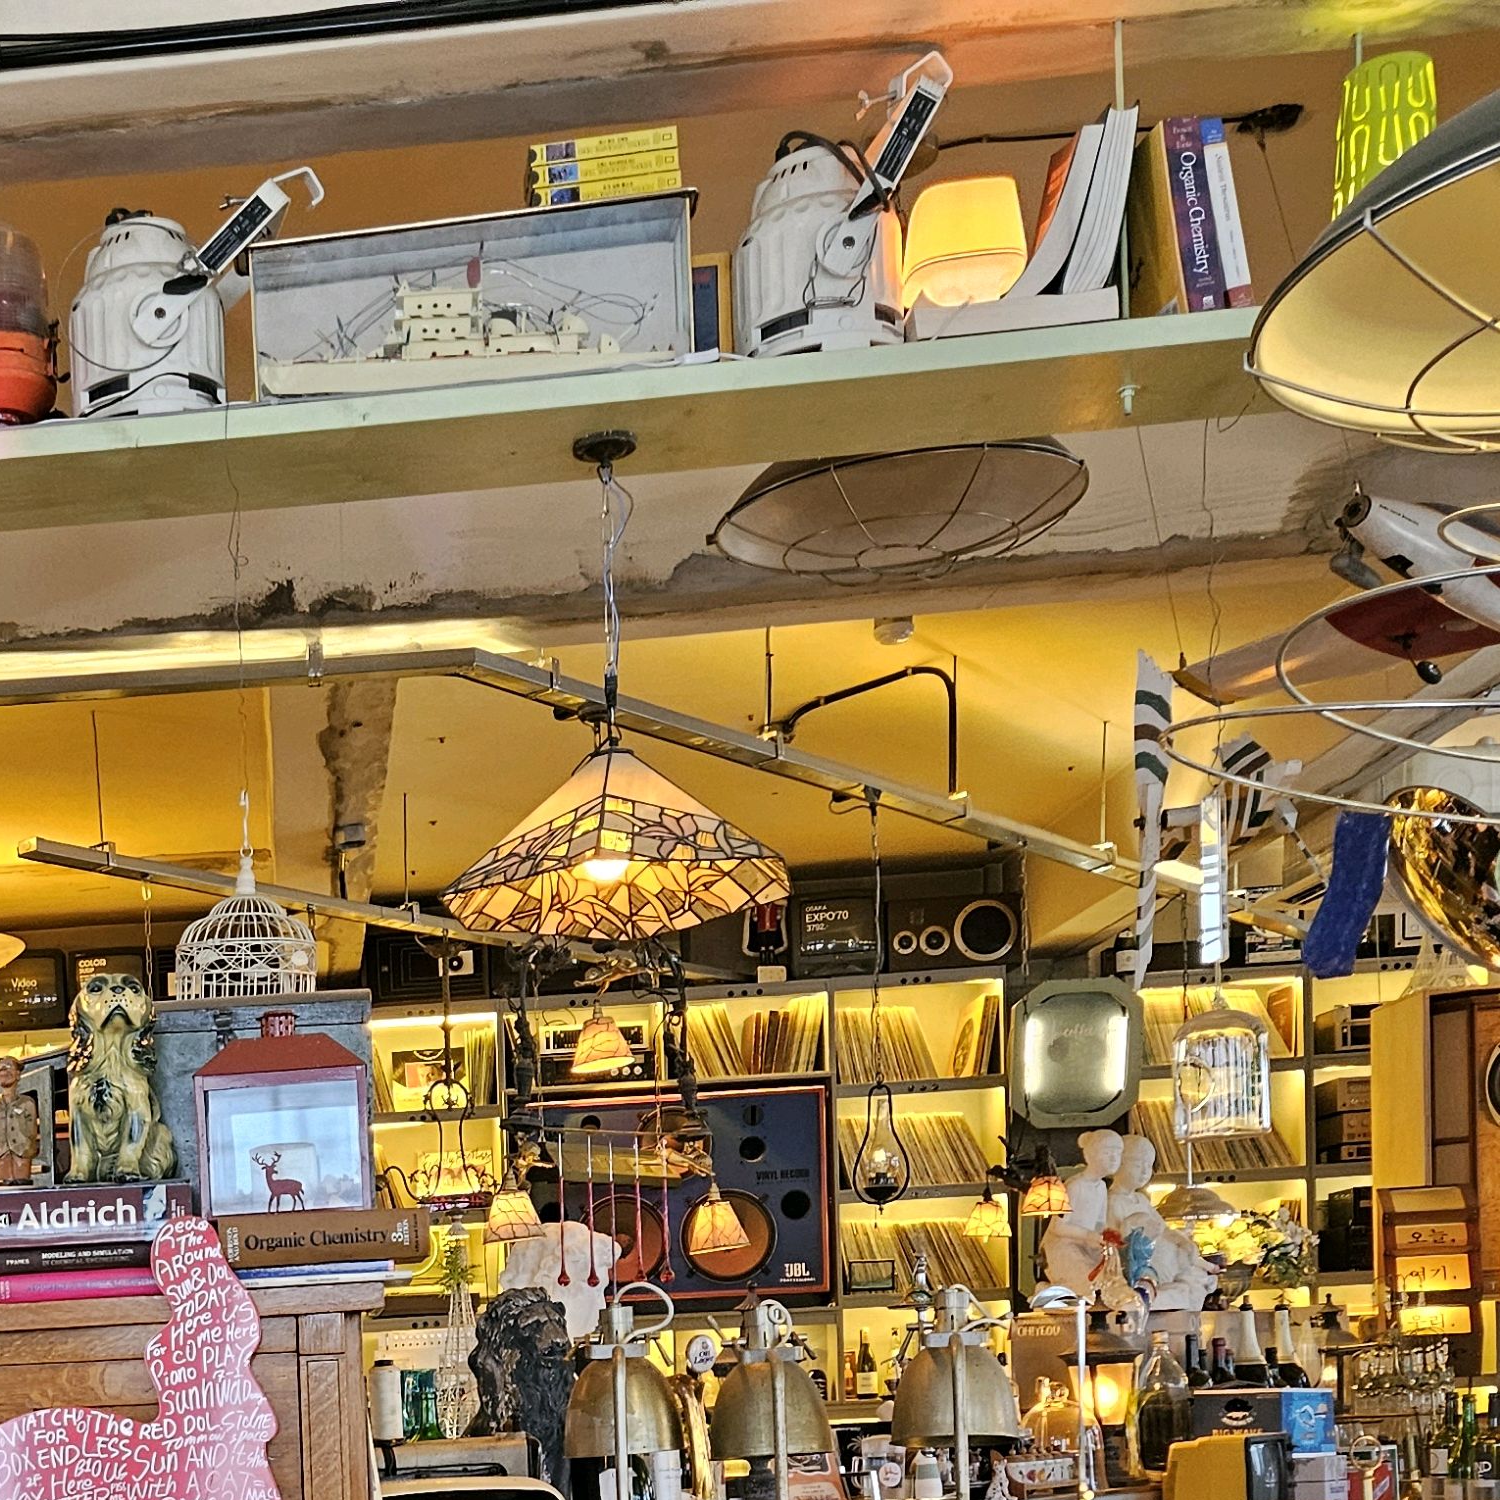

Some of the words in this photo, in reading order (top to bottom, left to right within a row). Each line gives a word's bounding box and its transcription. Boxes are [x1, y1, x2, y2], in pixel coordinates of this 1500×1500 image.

[1178, 151, 1200, 206] Organic
[1188, 206, 1210, 275] Chemistry
[78, 957, 107, 968] COLOR
[10, 977, 38, 989] Video
[16, 1198, 137, 1231] Aldrich
[244, 1231, 306, 1252] Organic
[309, 1227, 389, 1248] Chemistry
[41, 1251, 77, 1260] MODELING
[77, 1250, 92, 1258] AND
[92, 1249, 134, 1258] SIMULATION
[784, 1262, 810, 1277] JBL
[140, 1418, 177, 1440] RED
